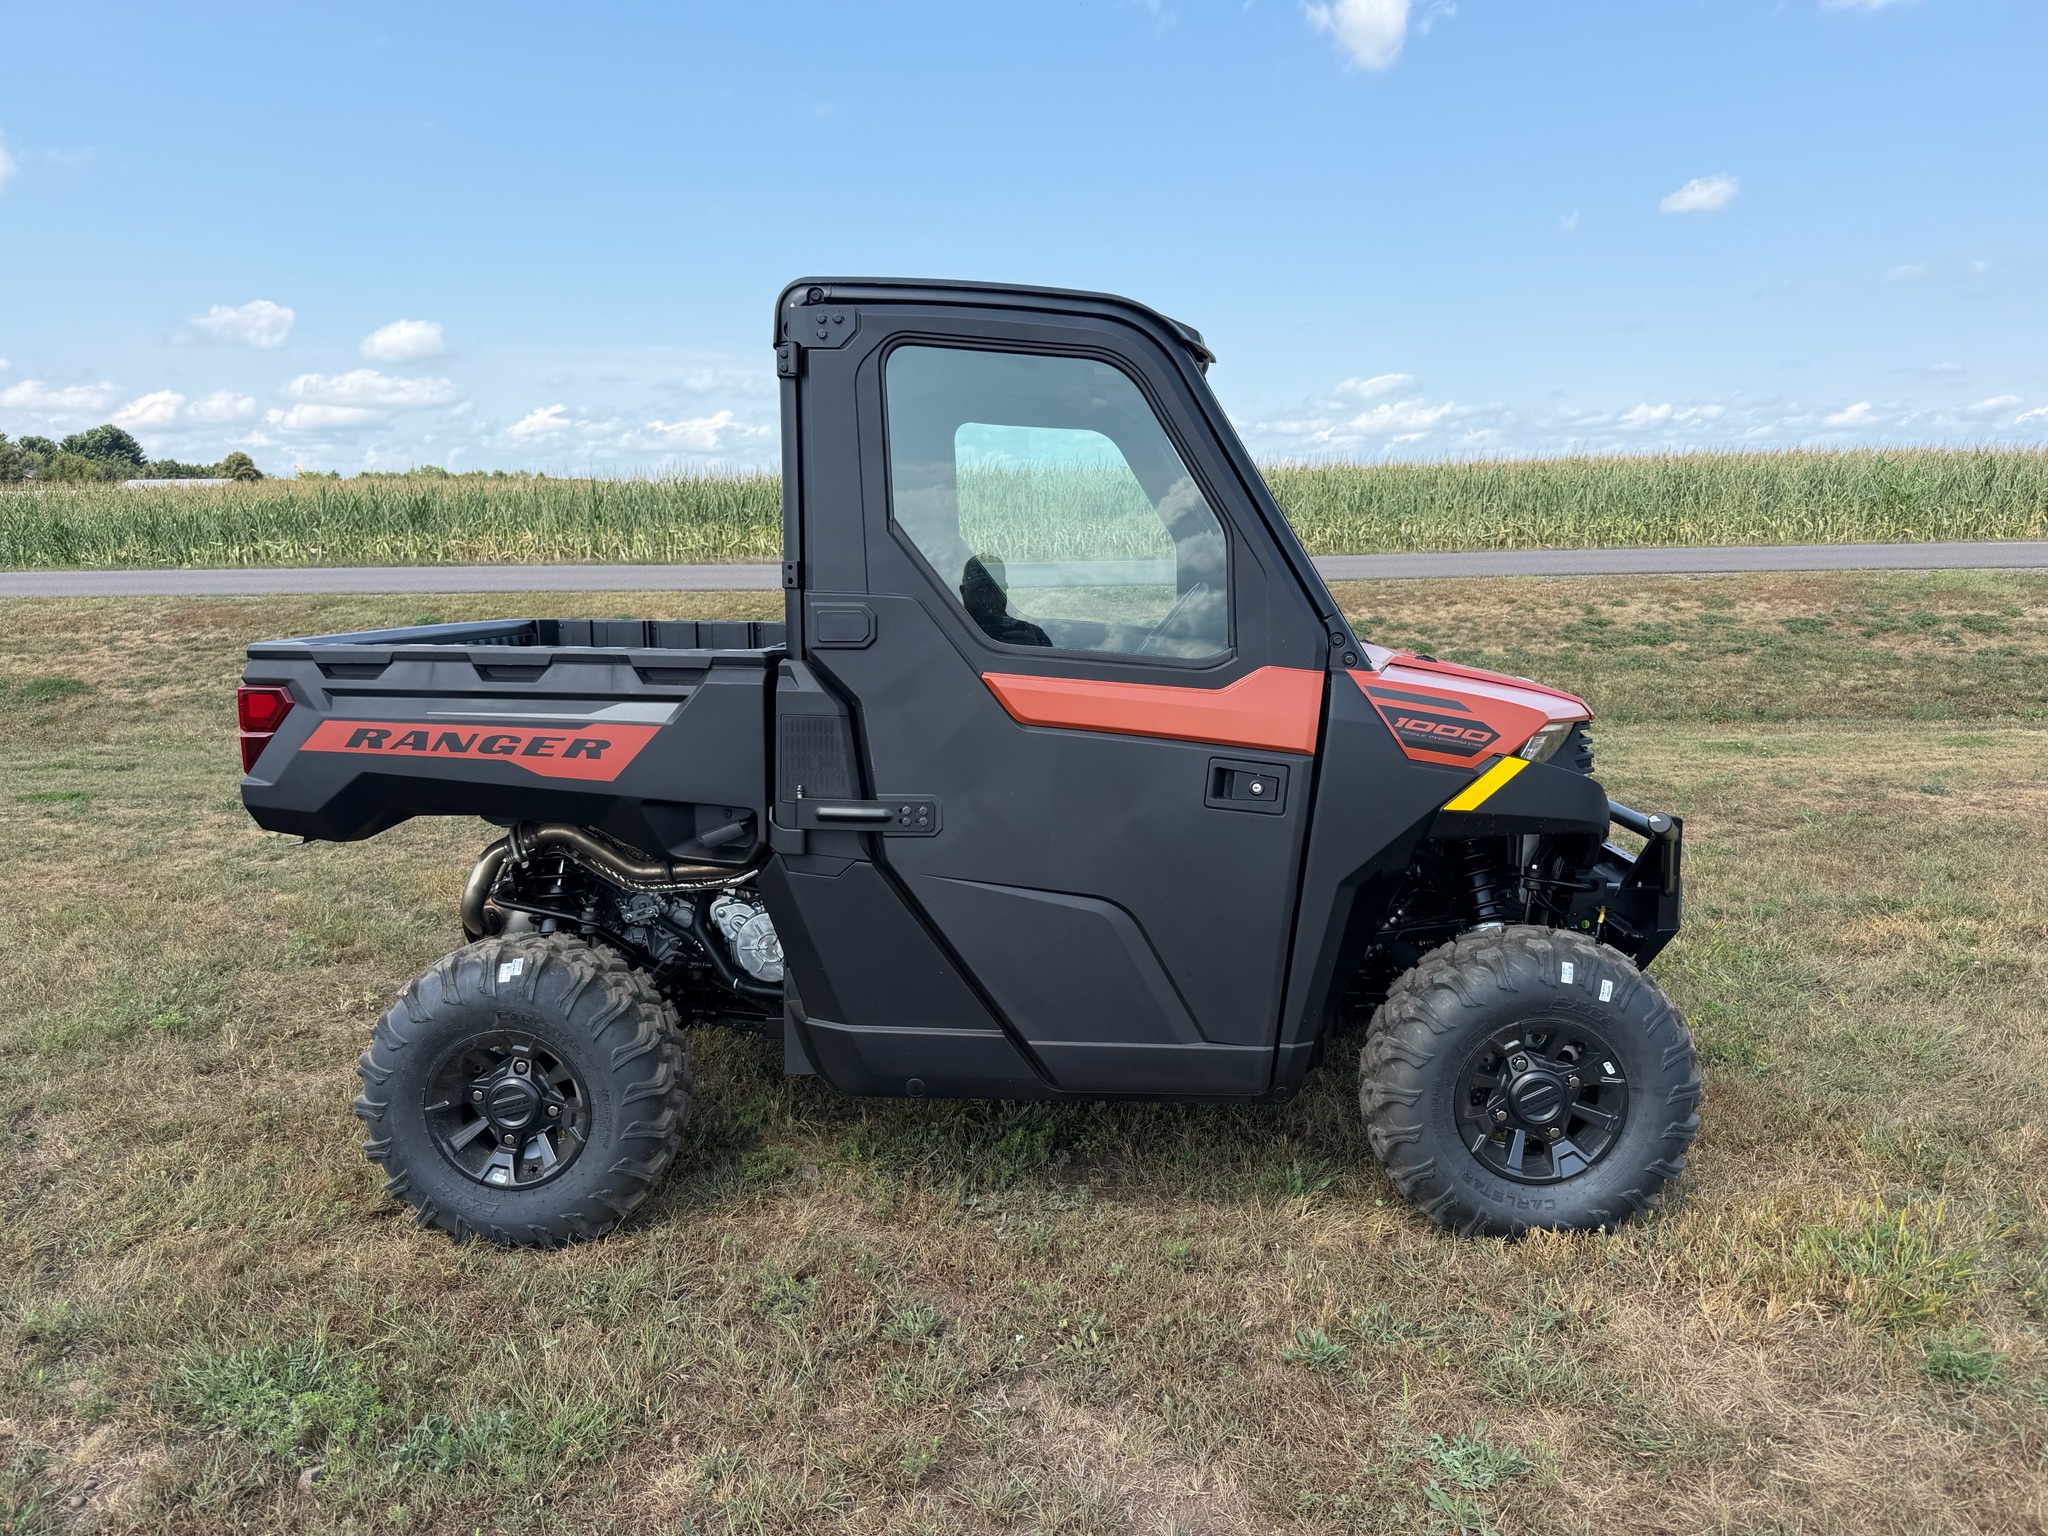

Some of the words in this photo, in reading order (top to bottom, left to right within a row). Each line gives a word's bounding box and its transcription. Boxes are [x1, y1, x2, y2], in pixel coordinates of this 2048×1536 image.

[345, 718, 611, 760] RANGER
[1394, 717, 1492, 742] 1000
[496, 1010, 586, 1056] CARLSTAR
[1460, 1169, 1556, 1211] CARLSTAR
